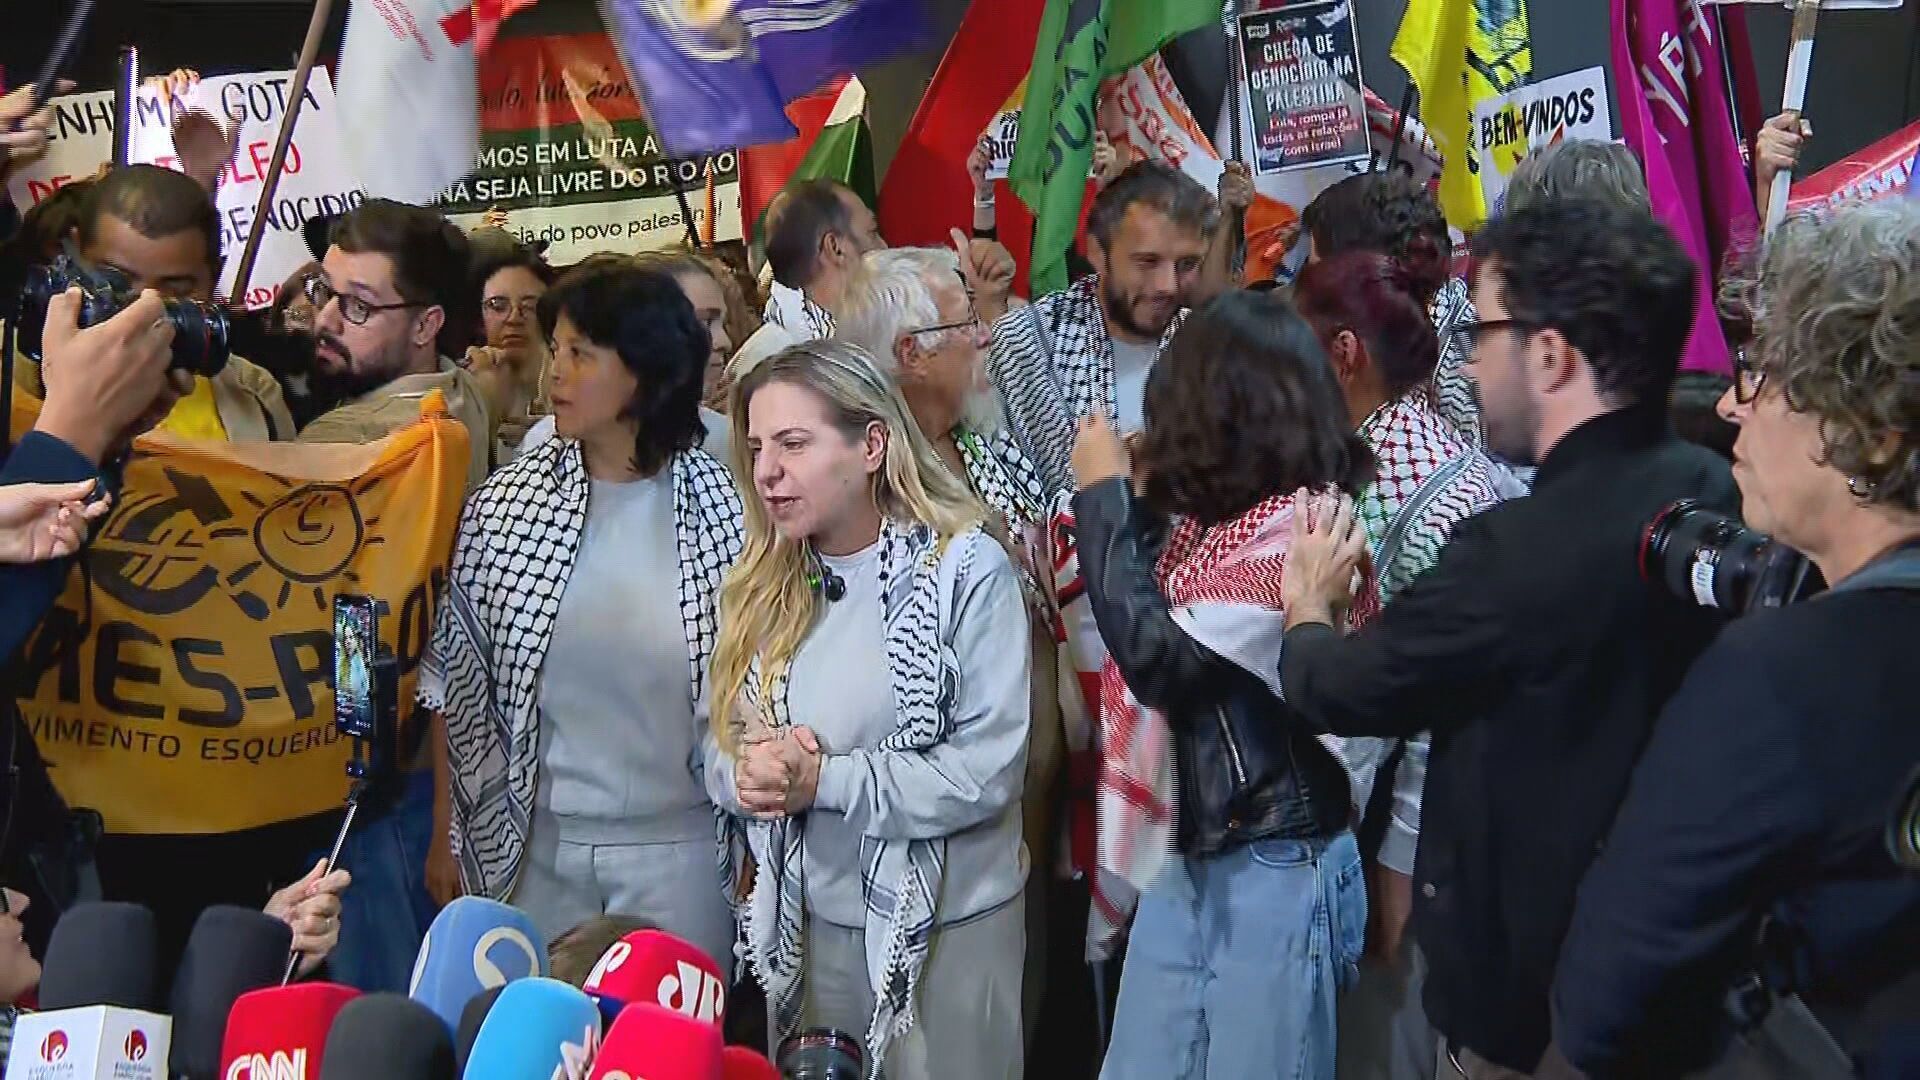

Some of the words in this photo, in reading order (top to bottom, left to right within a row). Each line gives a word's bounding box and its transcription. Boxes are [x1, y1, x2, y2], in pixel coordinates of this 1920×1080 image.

[1263, 37, 1312, 63] CHEGA
[1315, 33, 1336, 54] DE
[1333, 55, 1354, 76] NA
[1265, 80, 1346, 113] PALESTINA
[1480, 87, 1595, 151] BEM-VINDOS
[535, 141, 570, 164] EM
[575, 136, 638, 160] LUTA
[475, 175, 532, 200] SEJA
[537, 170, 604, 196] LIVRE
[610, 168, 647, 190] DO
[571, 222, 623, 244] povo
[225, 1047, 307, 1080] CNN
